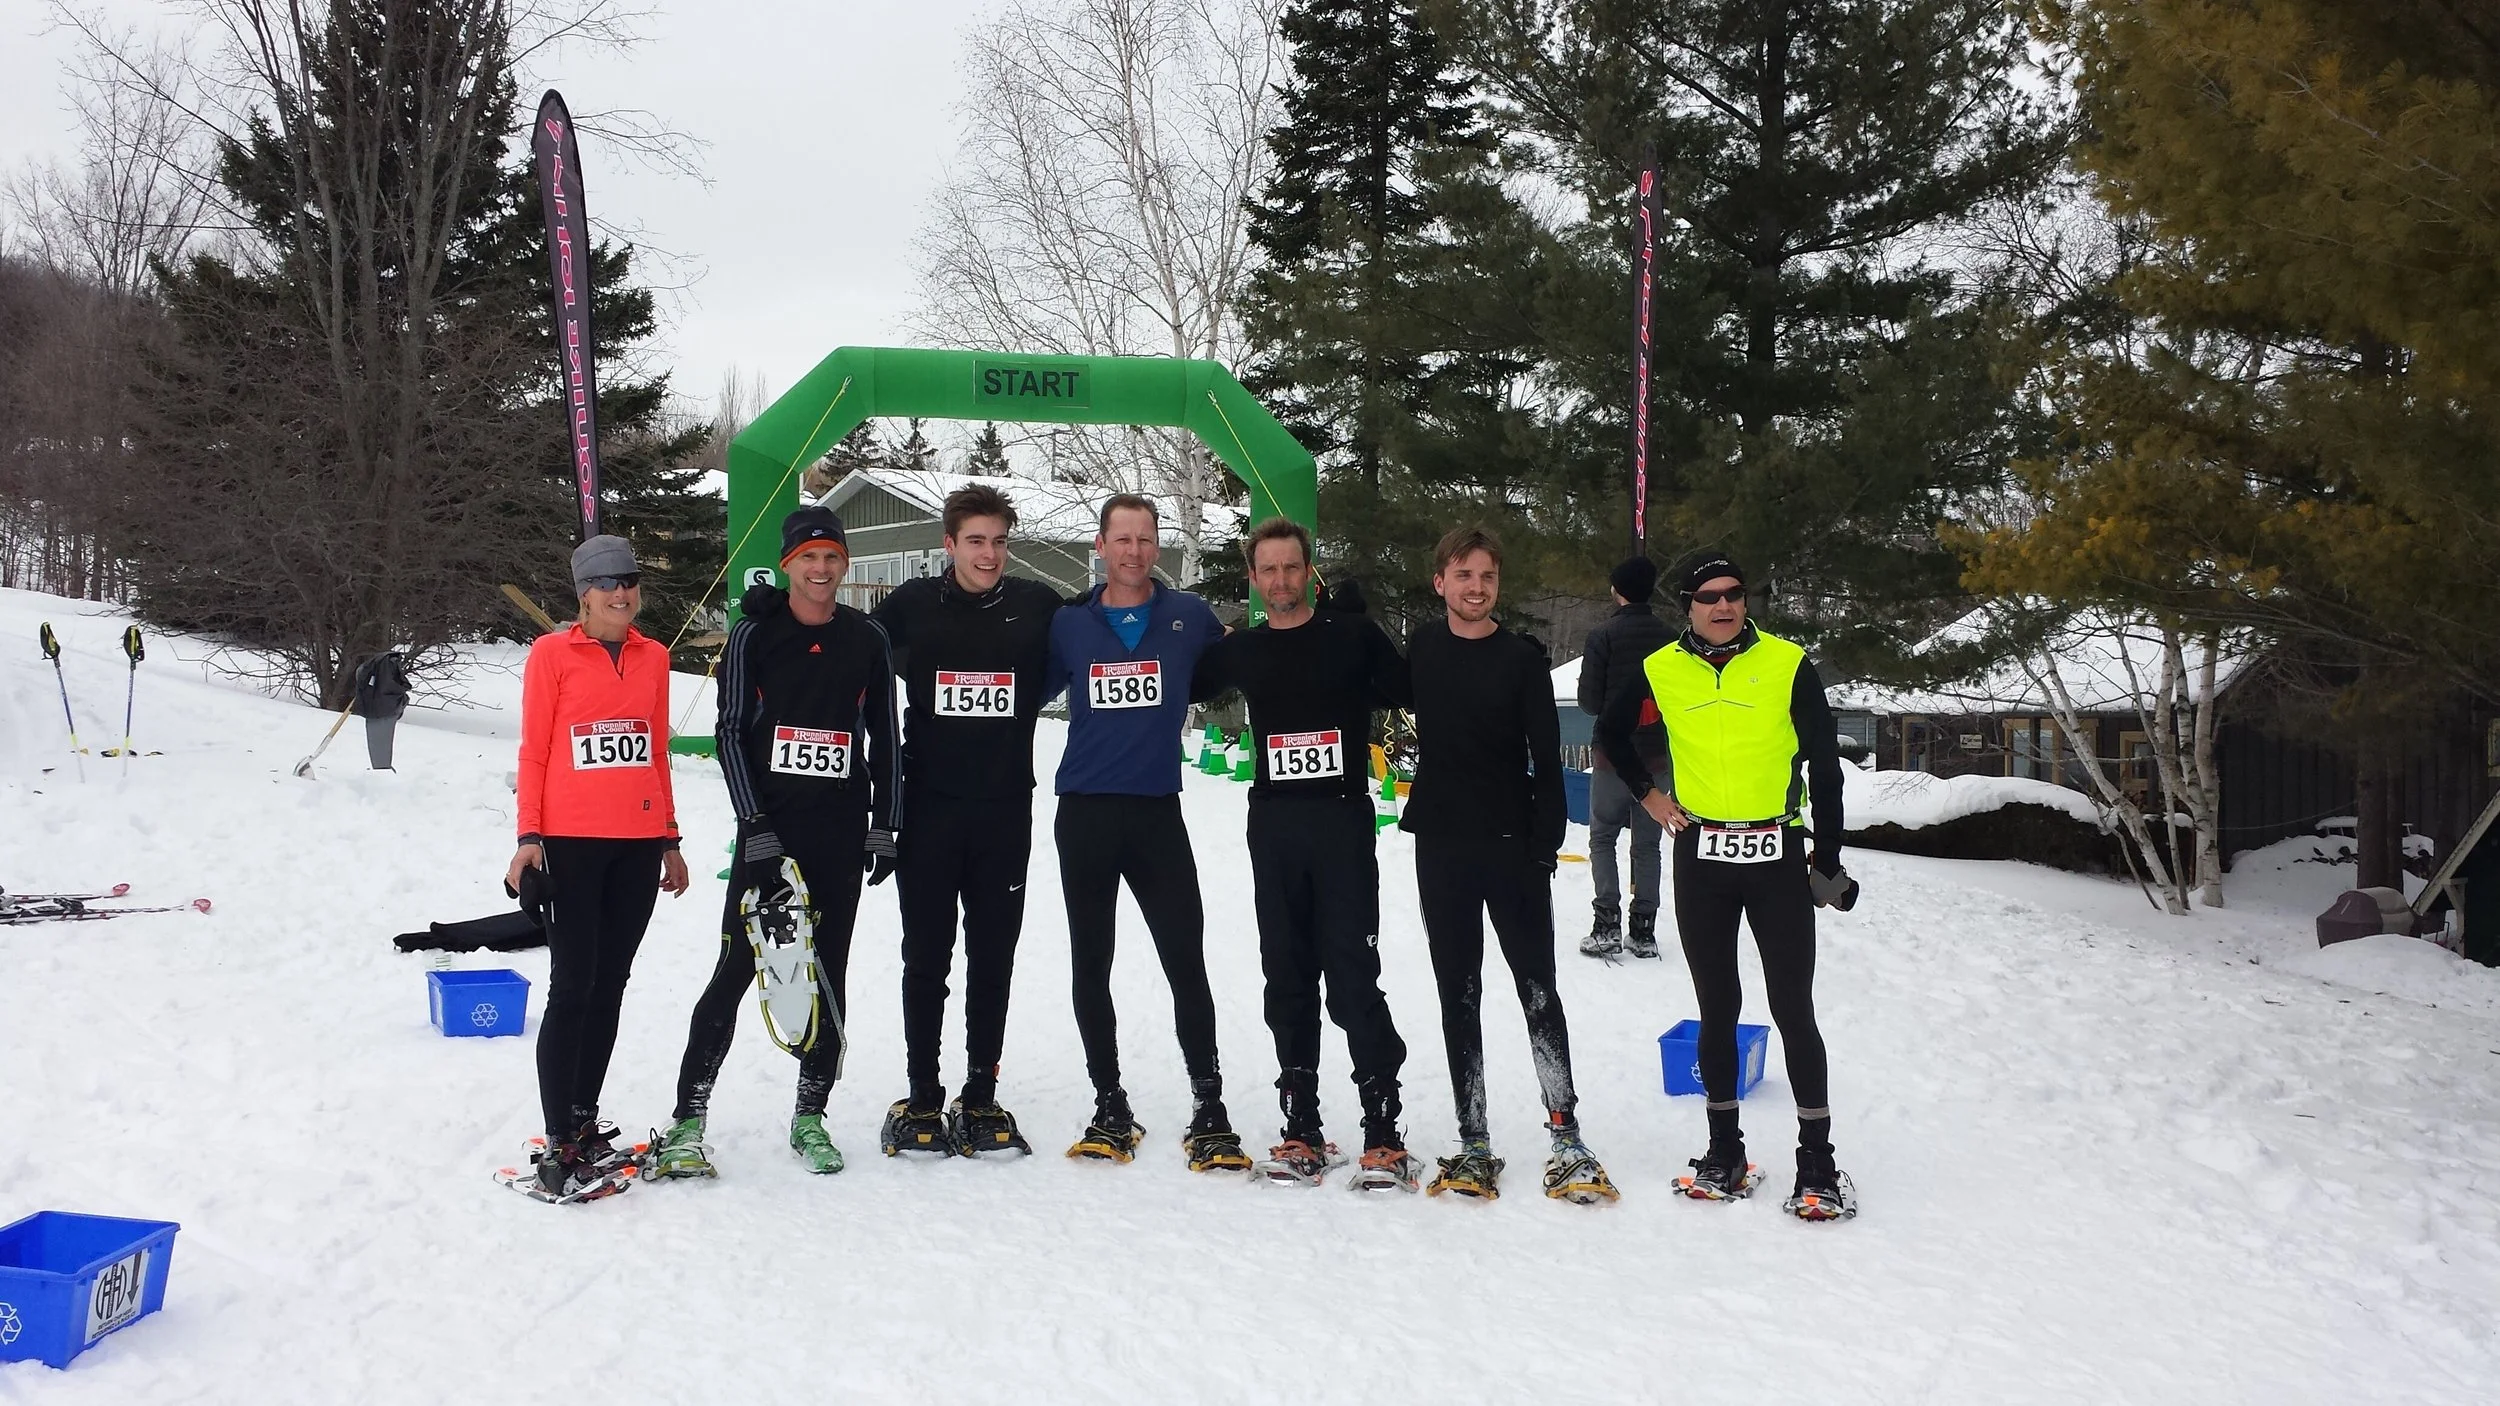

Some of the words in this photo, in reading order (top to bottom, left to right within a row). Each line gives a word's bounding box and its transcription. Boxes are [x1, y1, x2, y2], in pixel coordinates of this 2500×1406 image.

[983, 368, 1080, 398] START
[1635, 352, 1649, 540] SQUIRE
[942, 686, 1009, 713] 1546
[1094, 676, 1158, 704] 1586
[580, 735, 648, 765] 1502
[778, 742, 845, 773] 1553
[1274, 746, 1338, 776] 1581
[1705, 833, 1777, 859] 1556
